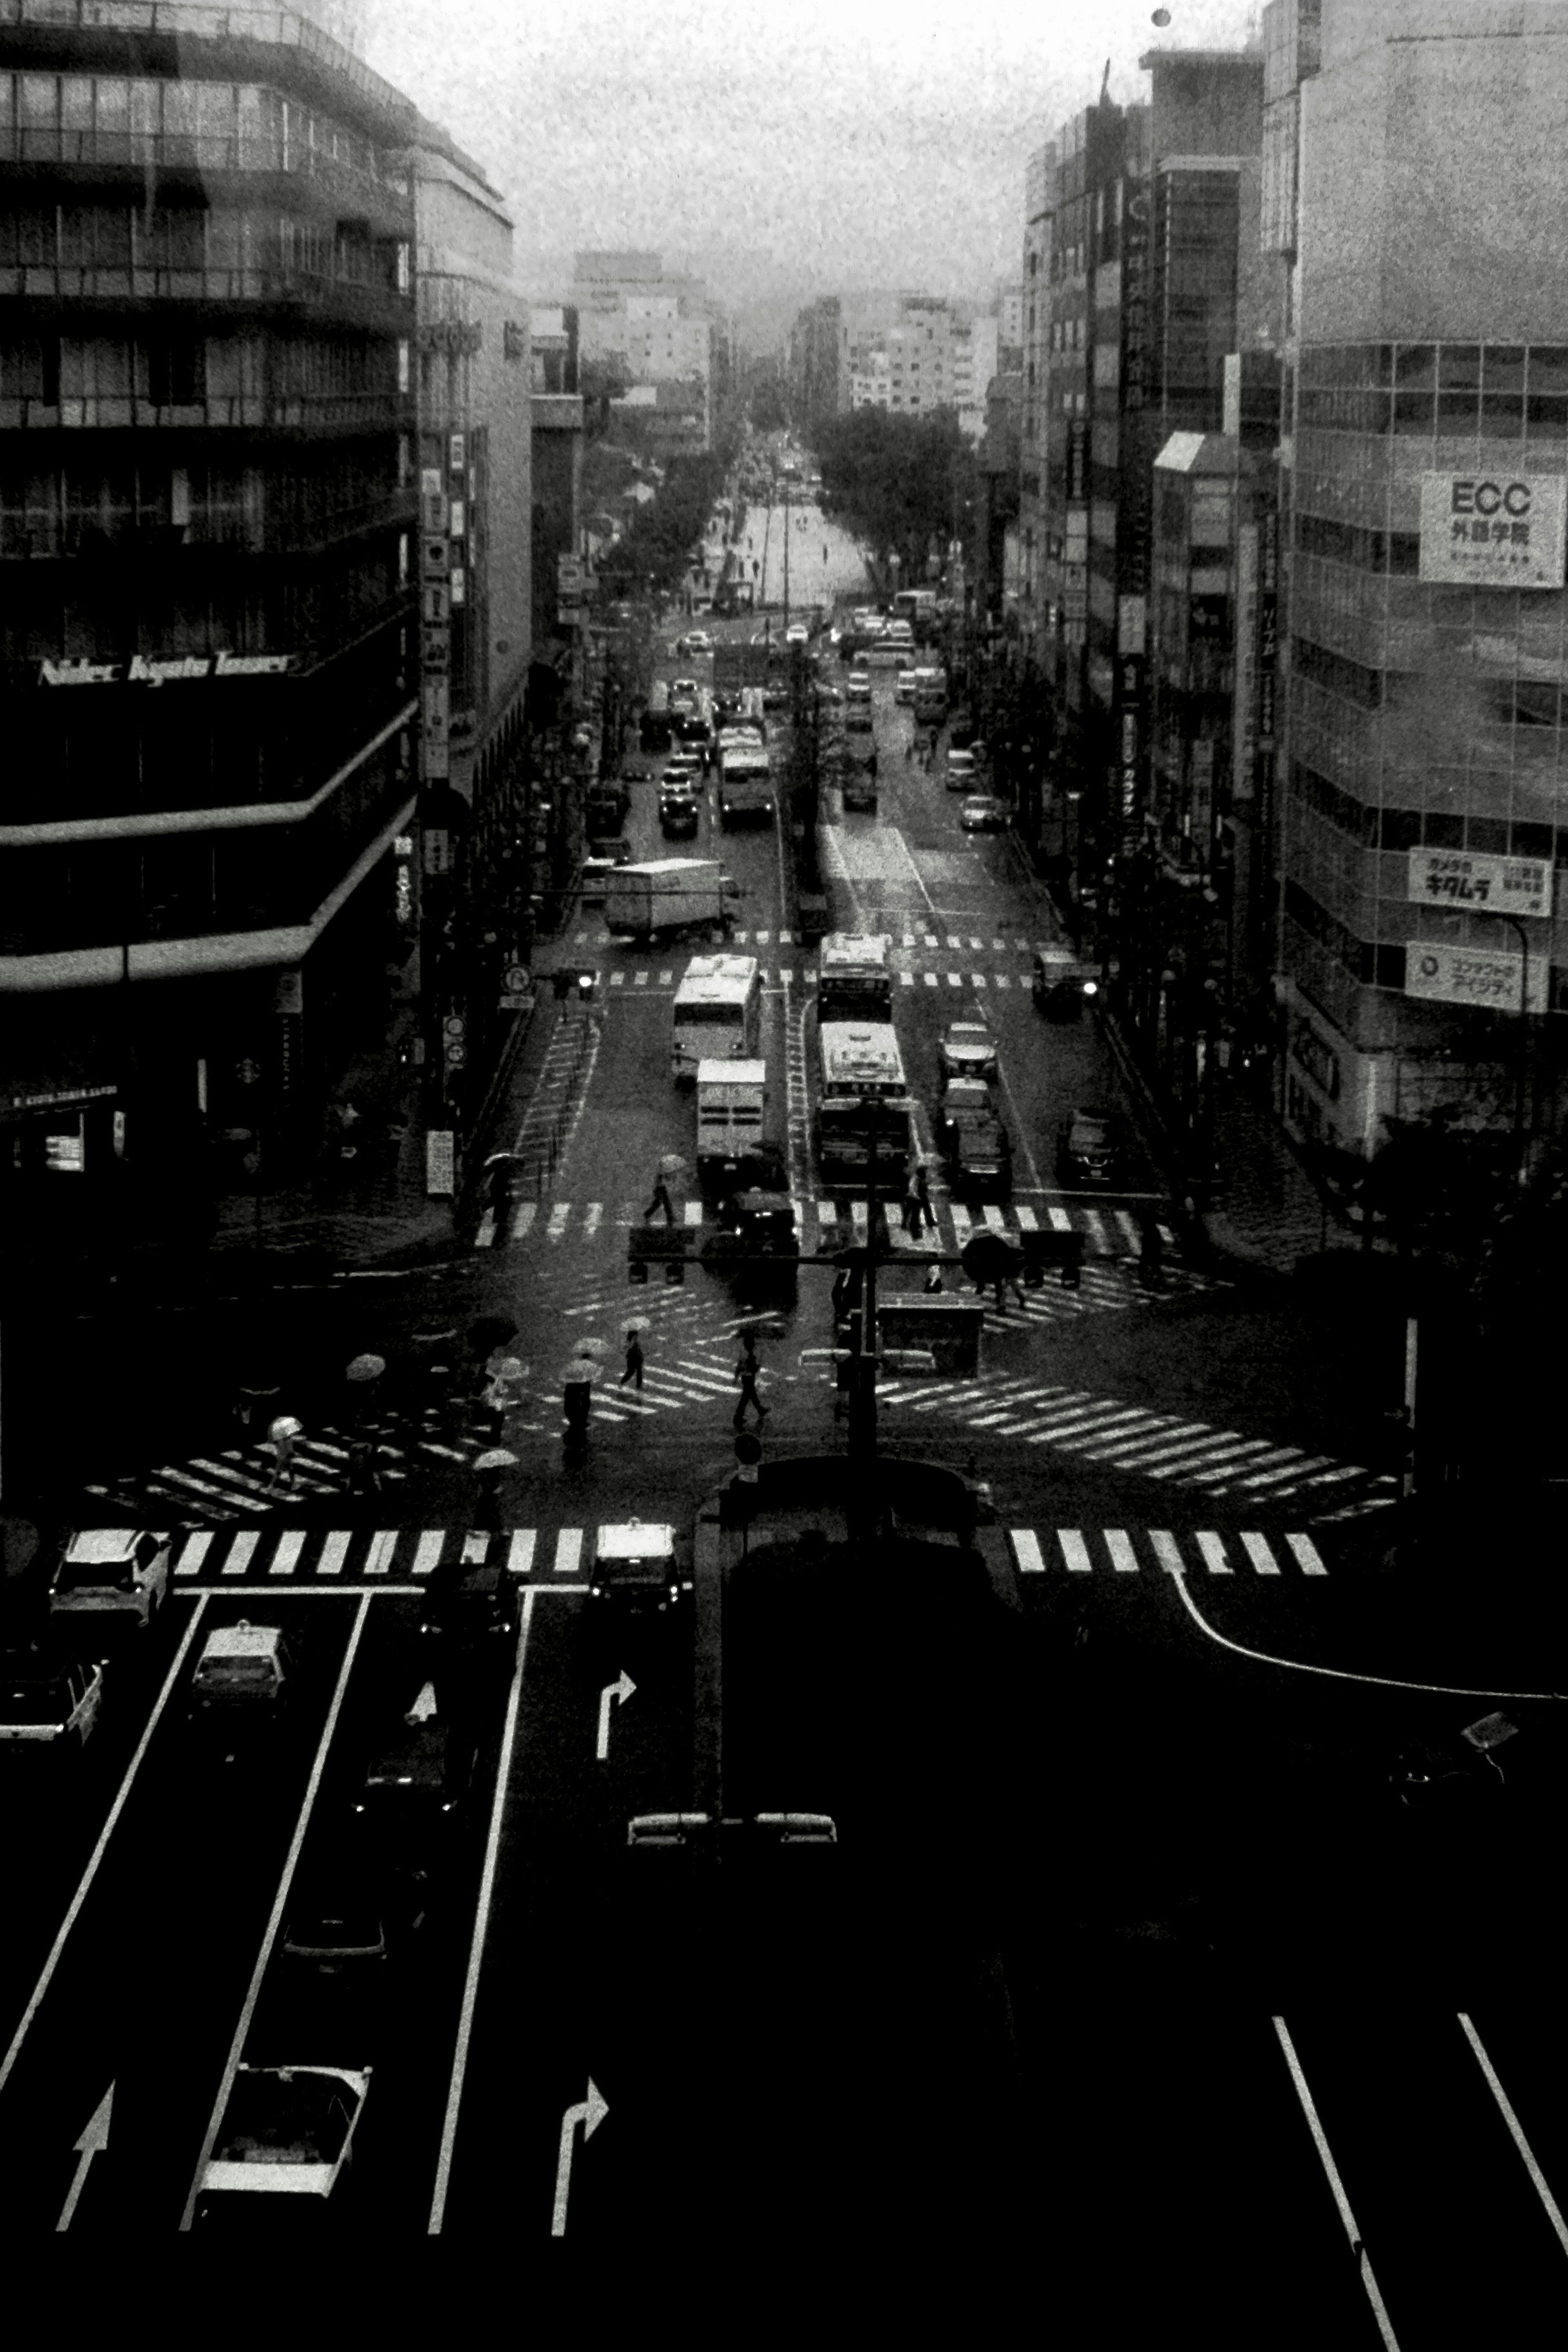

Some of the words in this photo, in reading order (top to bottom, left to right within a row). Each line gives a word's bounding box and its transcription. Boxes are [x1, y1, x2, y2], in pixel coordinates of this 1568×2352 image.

[1452, 481, 1531, 516] ECC
[1451, 518, 1530, 546] 外語学院
[127, 655, 211, 688] Kyoto
[1425, 874, 1491, 901] キタムラ
